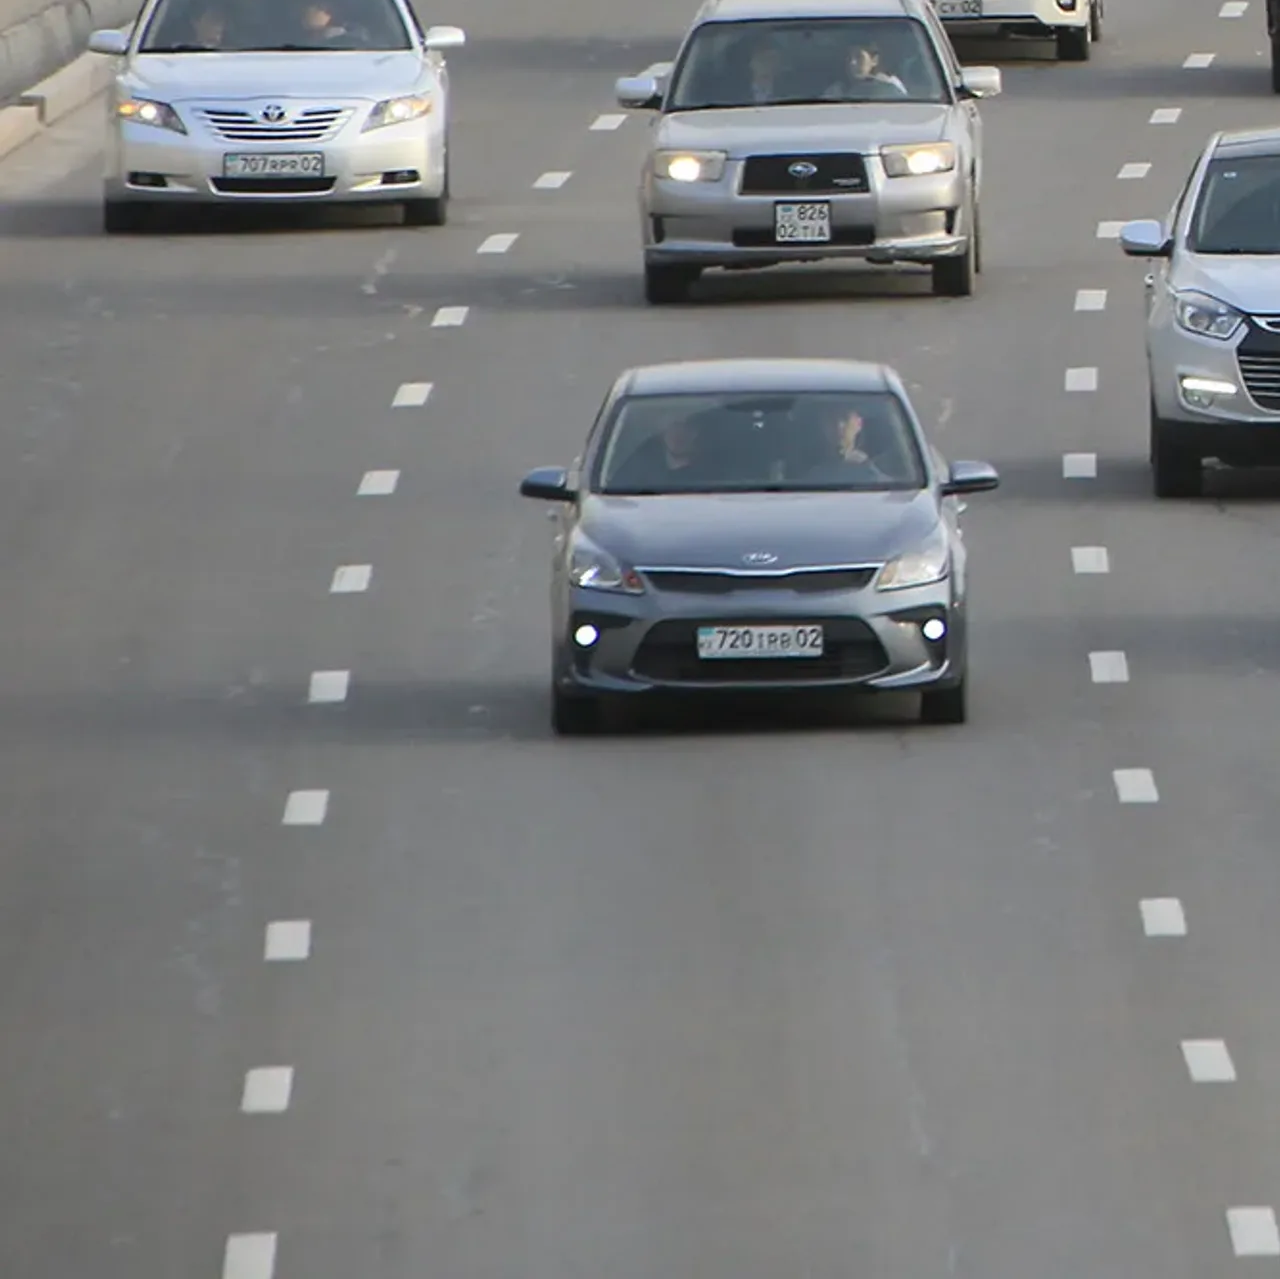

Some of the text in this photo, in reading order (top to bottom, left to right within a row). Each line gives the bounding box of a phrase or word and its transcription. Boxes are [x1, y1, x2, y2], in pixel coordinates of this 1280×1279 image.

[240, 157, 268, 172] 707
[301, 156, 321, 171] 02
[778, 223, 797, 238] 02
[716, 629, 753, 649] 720
[796, 628, 821, 649] 02
